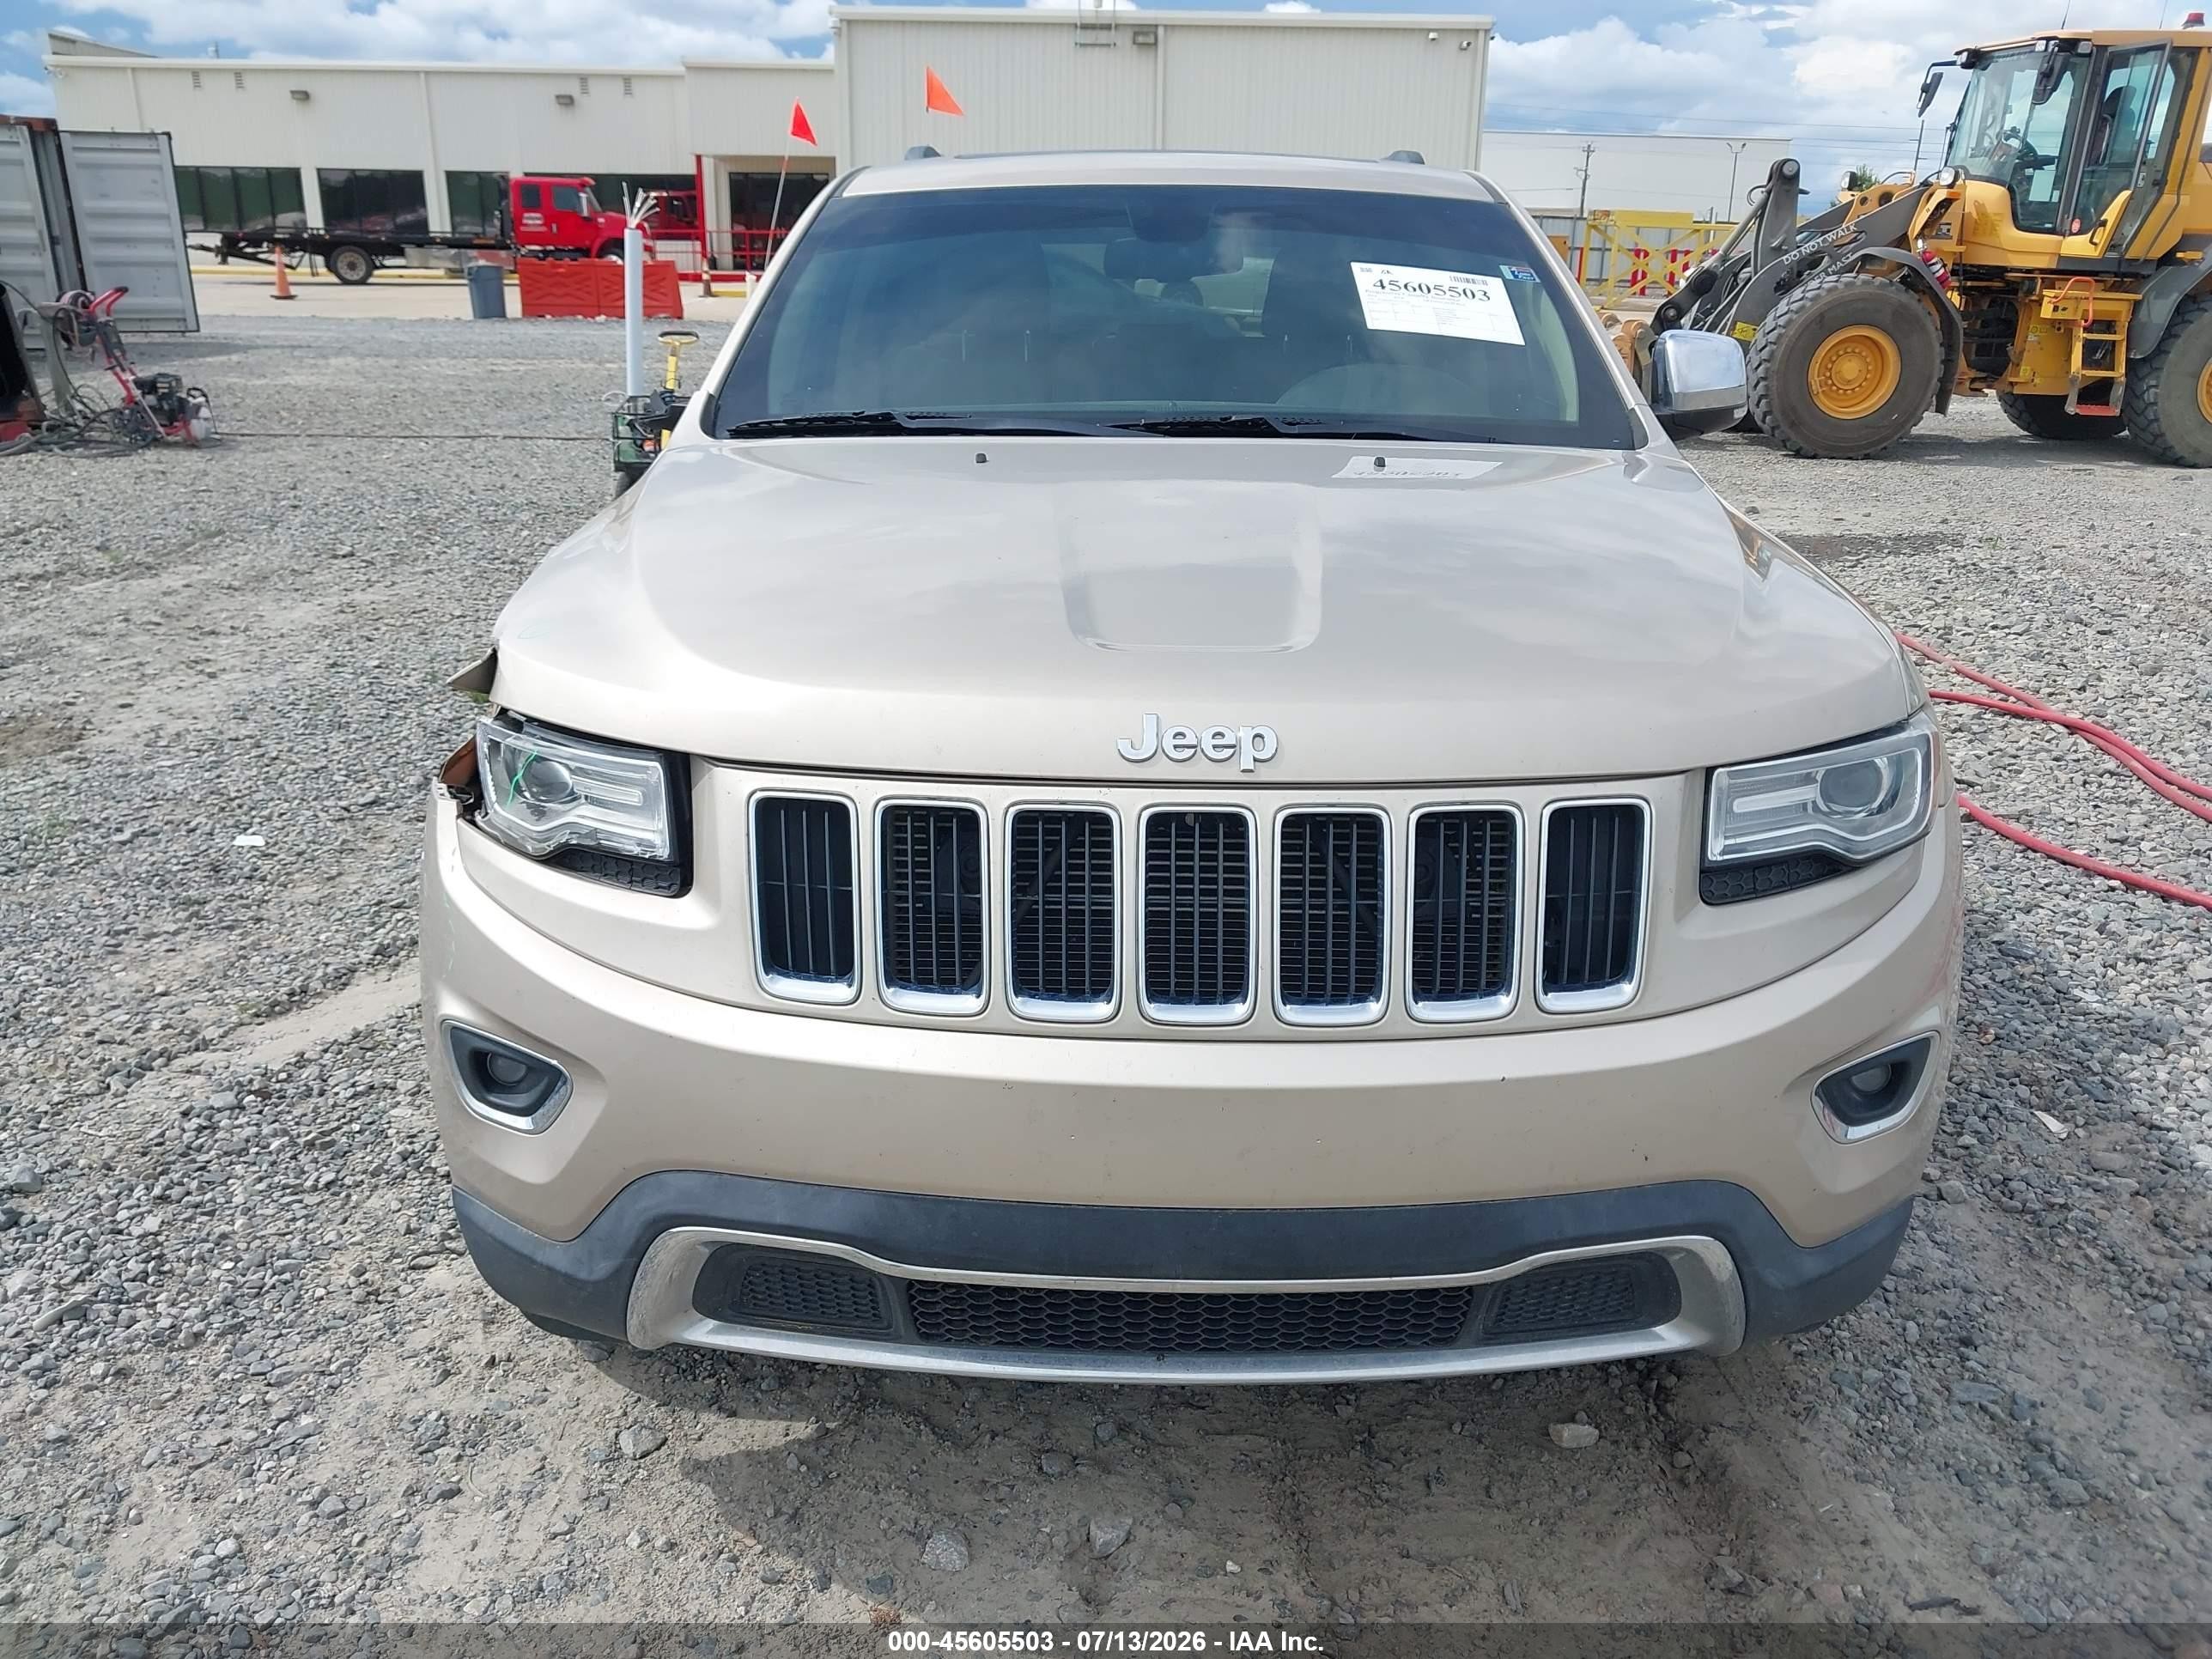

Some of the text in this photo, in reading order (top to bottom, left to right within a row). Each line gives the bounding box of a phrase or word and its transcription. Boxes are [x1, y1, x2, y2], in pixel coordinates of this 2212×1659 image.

[1783, 223, 1857, 265] DO NOT WALK
[1373, 278, 1491, 302] 45605503
[1116, 713, 1279, 773] Jeep
